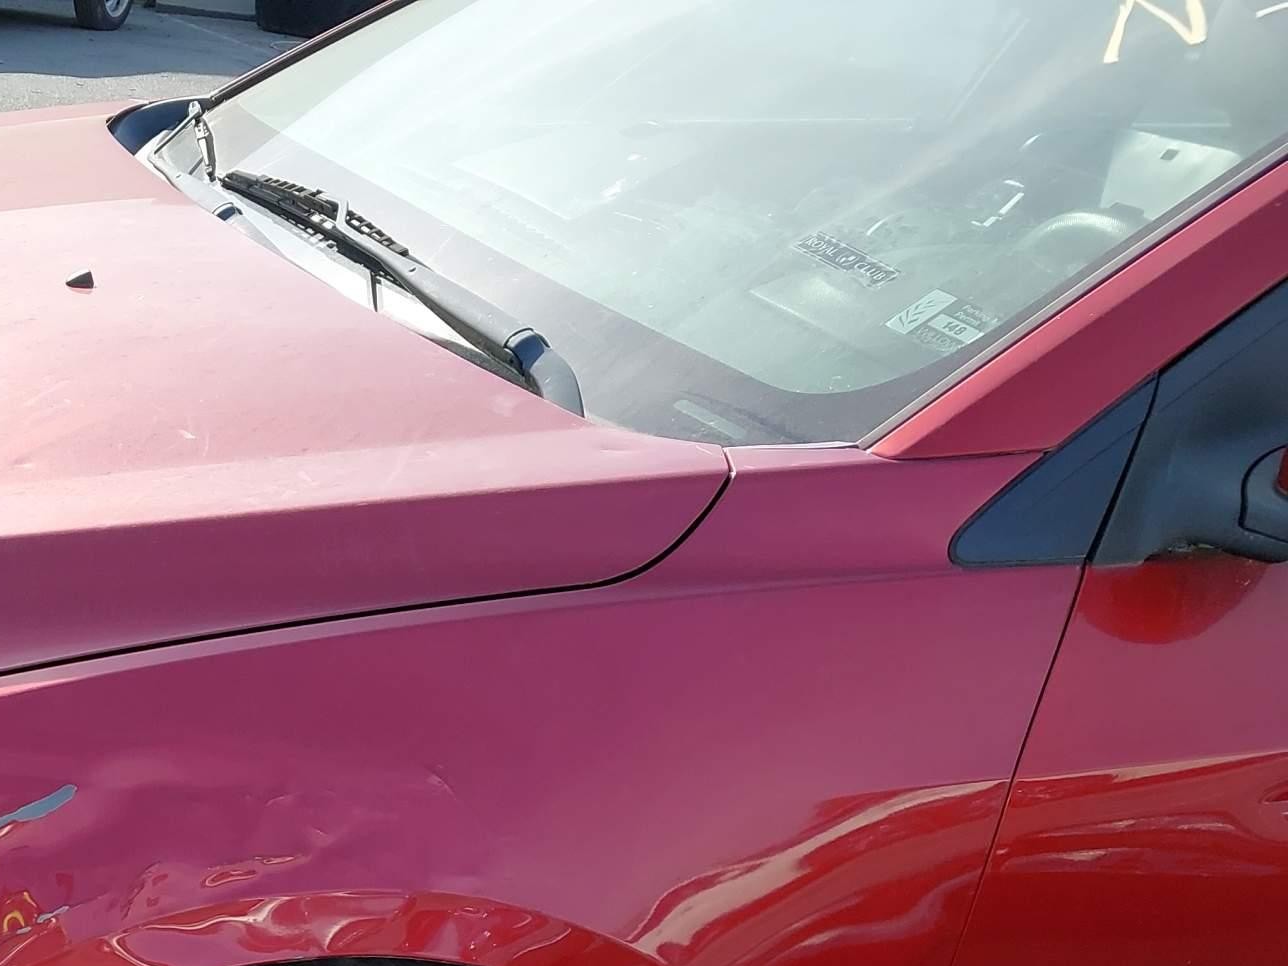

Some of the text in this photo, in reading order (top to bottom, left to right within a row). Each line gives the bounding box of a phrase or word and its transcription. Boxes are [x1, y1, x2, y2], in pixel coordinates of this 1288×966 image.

[805, 238, 886, 281] ROYAL CLUB
[942, 321, 968, 336] 148
